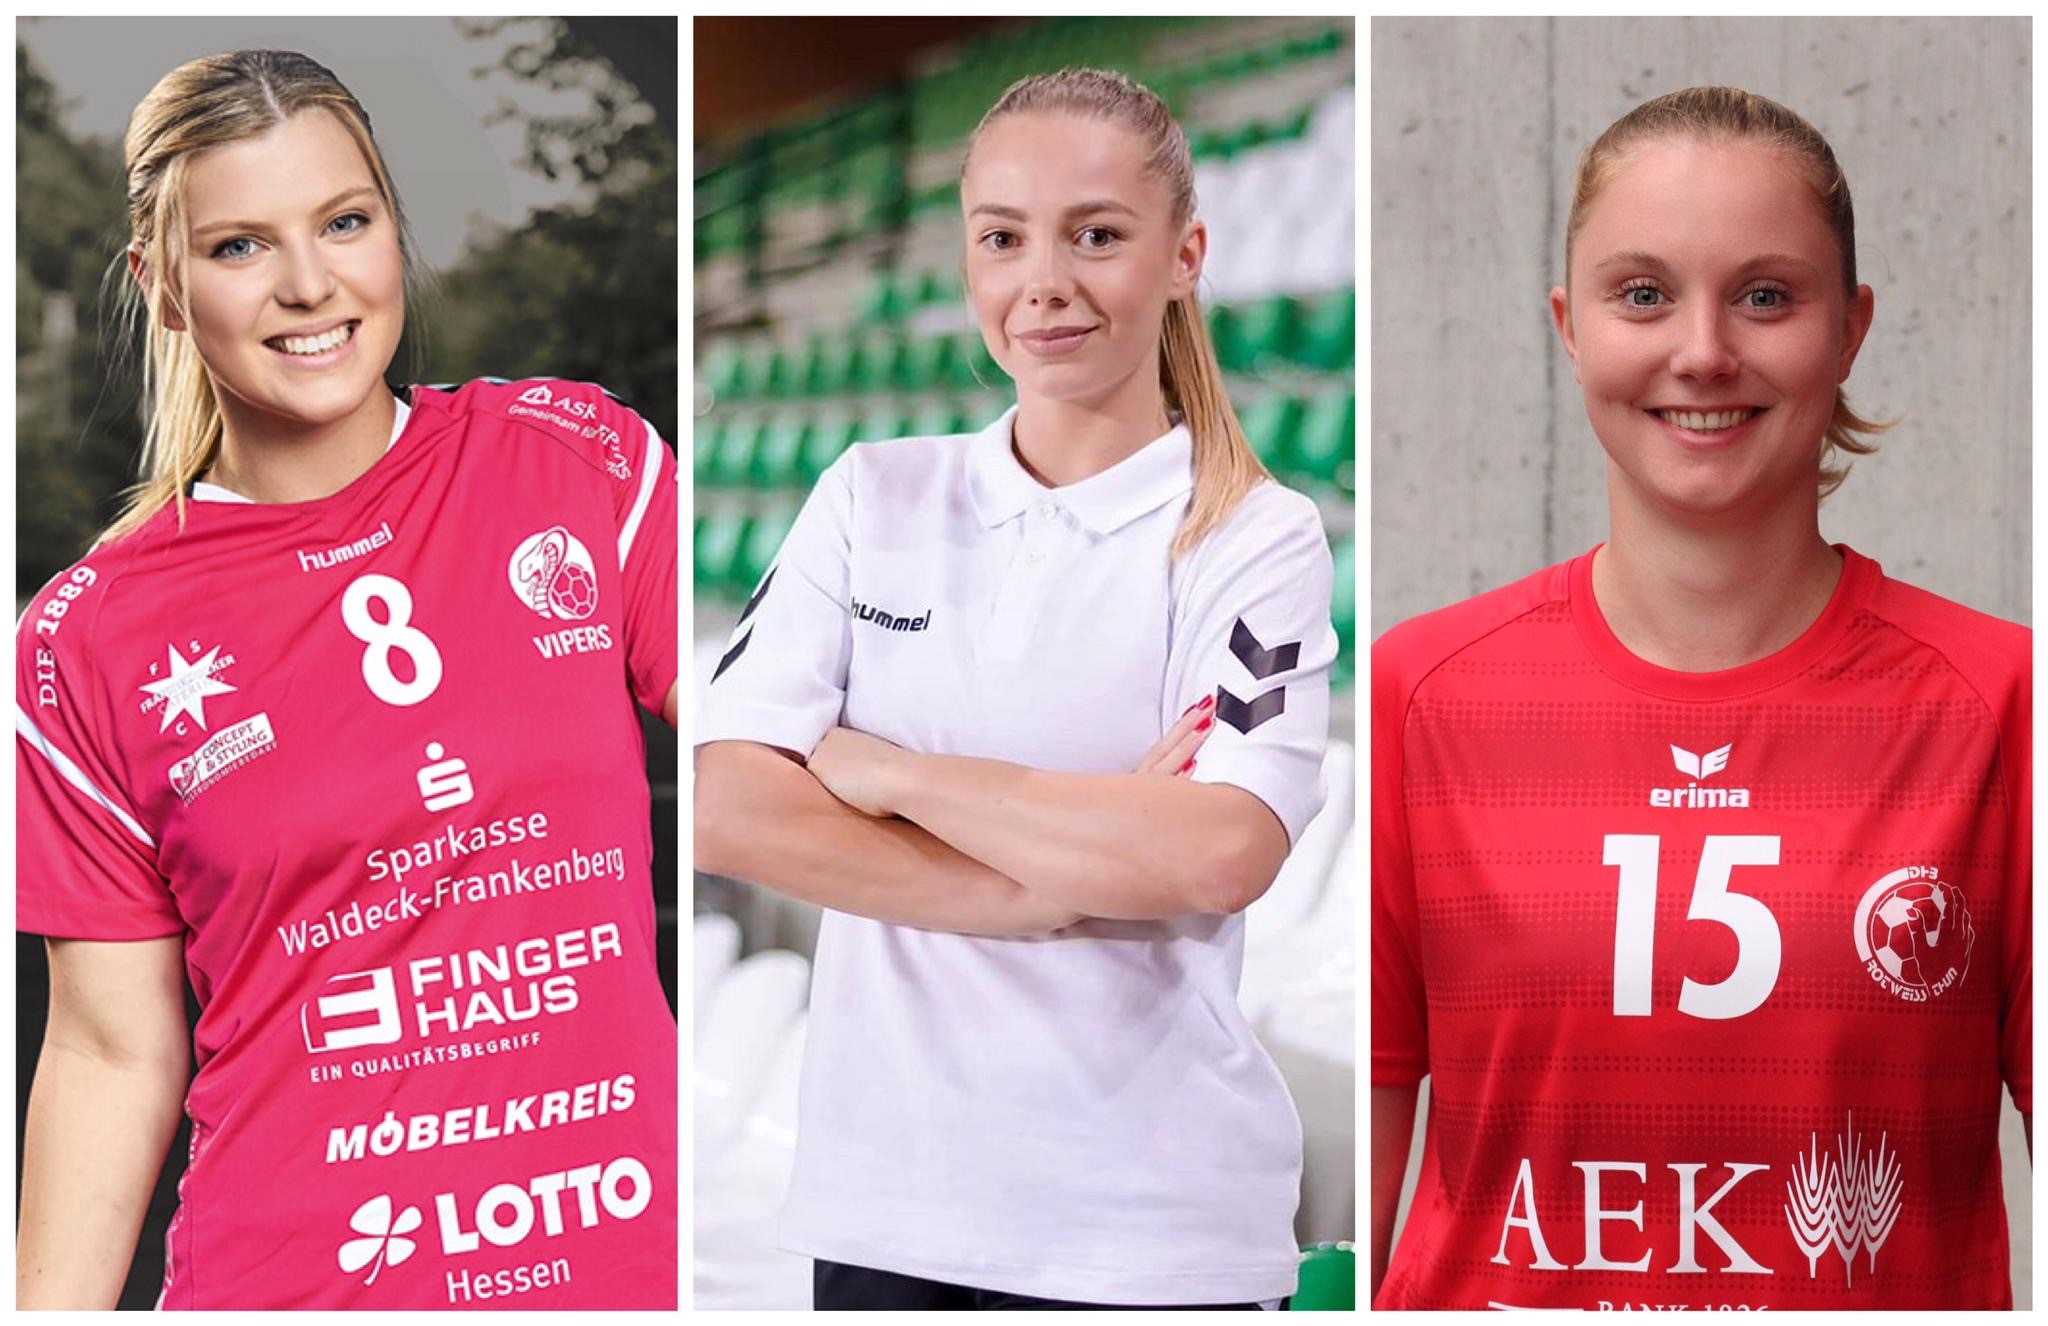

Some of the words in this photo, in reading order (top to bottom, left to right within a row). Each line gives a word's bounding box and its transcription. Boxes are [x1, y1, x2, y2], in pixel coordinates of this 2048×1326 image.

[508, 404, 580, 433] Gemeinsam
[297, 521, 394, 573] hummel
[36, 566, 97, 636] 1889
[850, 595, 932, 633] hummel
[341, 573, 443, 707] 8
[533, 624, 613, 659] VIPERS
[36, 648, 59, 708] DIE
[202, 722, 254, 760] CONCEPT
[216, 730, 268, 765] STYLING
[1649, 782, 1751, 809] erima
[366, 812, 548, 882] Sparkasse
[277, 848, 625, 957] Waldeck-Frankenberg
[1602, 833, 1782, 1020] 15
[409, 922, 623, 997] FINGER
[416, 974, 580, 1038] HAUS
[310, 1063, 343, 1084] EIN
[351, 1031, 541, 1078] QUALITÄTSBEGRIFF
[434, 1156, 653, 1256] LOTTO
[1490, 1157, 1775, 1276] AEK
[445, 1257, 571, 1304] Hessen
